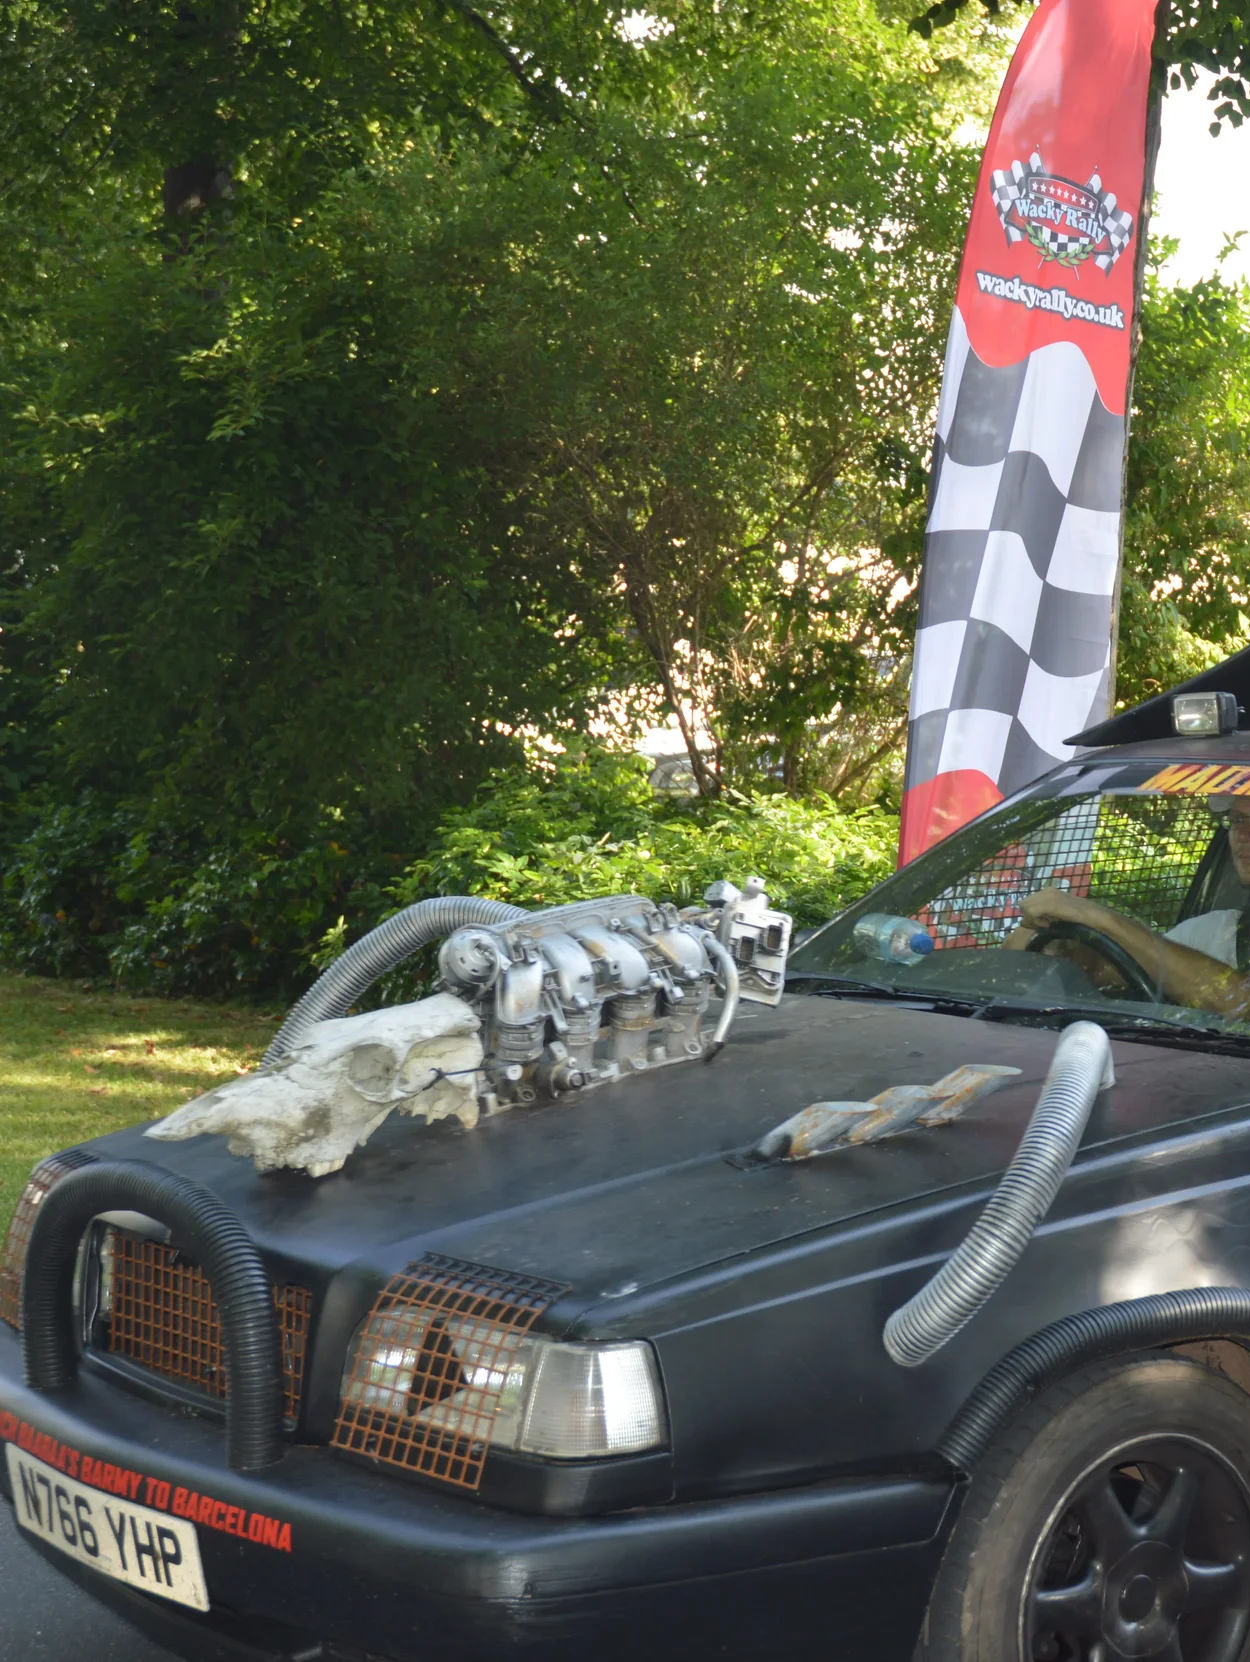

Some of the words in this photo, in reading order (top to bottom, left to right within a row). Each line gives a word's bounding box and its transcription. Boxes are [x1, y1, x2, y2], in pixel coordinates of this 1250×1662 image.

[1014, 196, 1064, 226] Wacky
[1065, 207, 1107, 245] Rally
[975, 271, 1125, 330] wackyrally.co.uk
[18, 1460, 100, 1558] N766
[104, 1506, 183, 1588] YHP
[80, 1455, 144, 1500] BARMY
[145, 1476, 171, 1507] TO
[171, 1486, 293, 1553] BARCELONA
